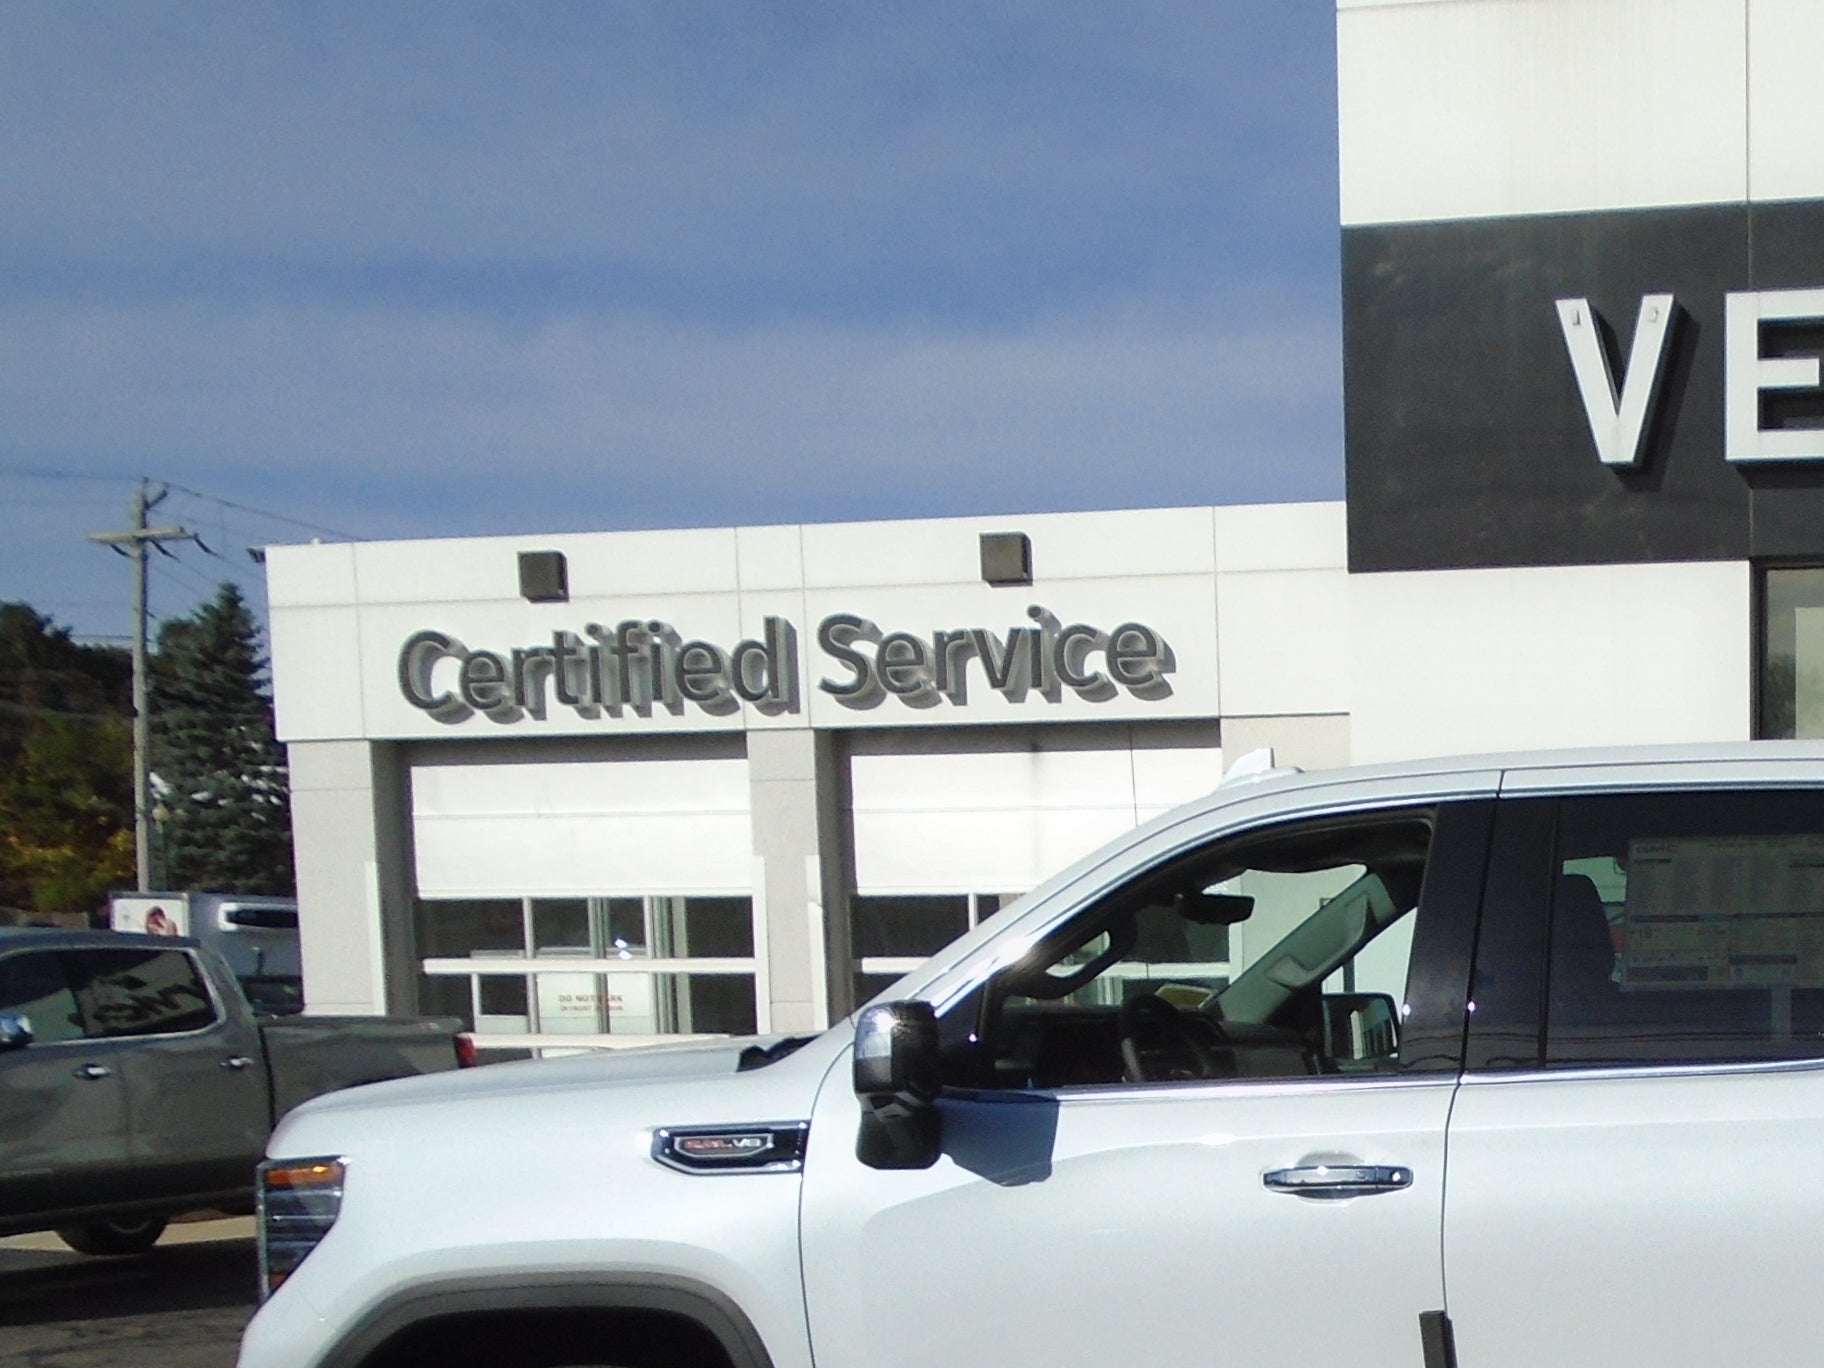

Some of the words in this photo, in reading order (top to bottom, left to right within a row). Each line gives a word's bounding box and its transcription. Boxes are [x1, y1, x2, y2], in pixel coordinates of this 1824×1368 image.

[398, 615, 799, 722] Certified
[817, 605, 1174, 709] Service
[559, 994, 572, 1003] DO
[576, 994, 595, 1003] NOT
